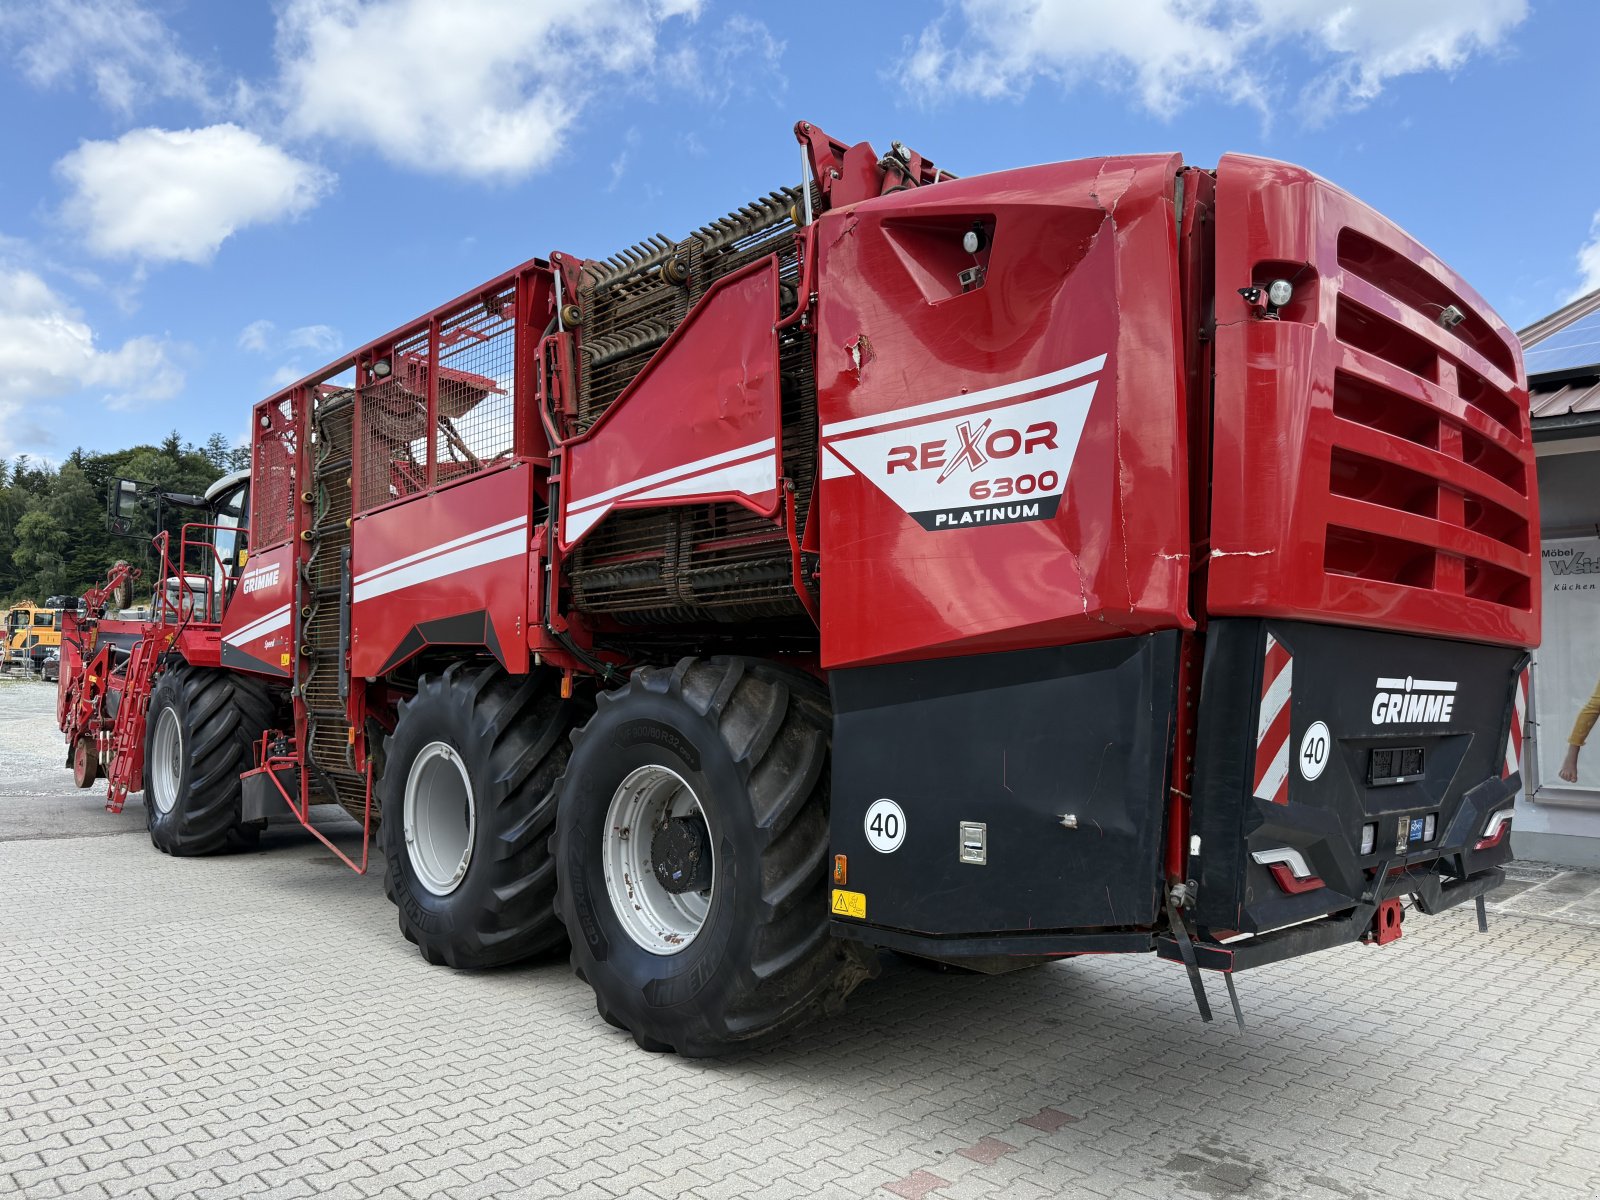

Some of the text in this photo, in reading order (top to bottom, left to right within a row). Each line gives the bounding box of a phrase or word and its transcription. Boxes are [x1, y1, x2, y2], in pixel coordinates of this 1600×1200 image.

[886, 418, 1059, 485] REXOR
[969, 470, 1059, 500] 6300
[935, 503, 1039, 527] PLATINUM
[1542, 548, 1574, 558] Möbel
[243, 569, 280, 595] GRIMME
[1553, 583, 1596, 592] Küchen
[1371, 692, 1455, 725] GRIMME
[1303, 736, 1326, 765] 40
[870, 812, 899, 839] 40
